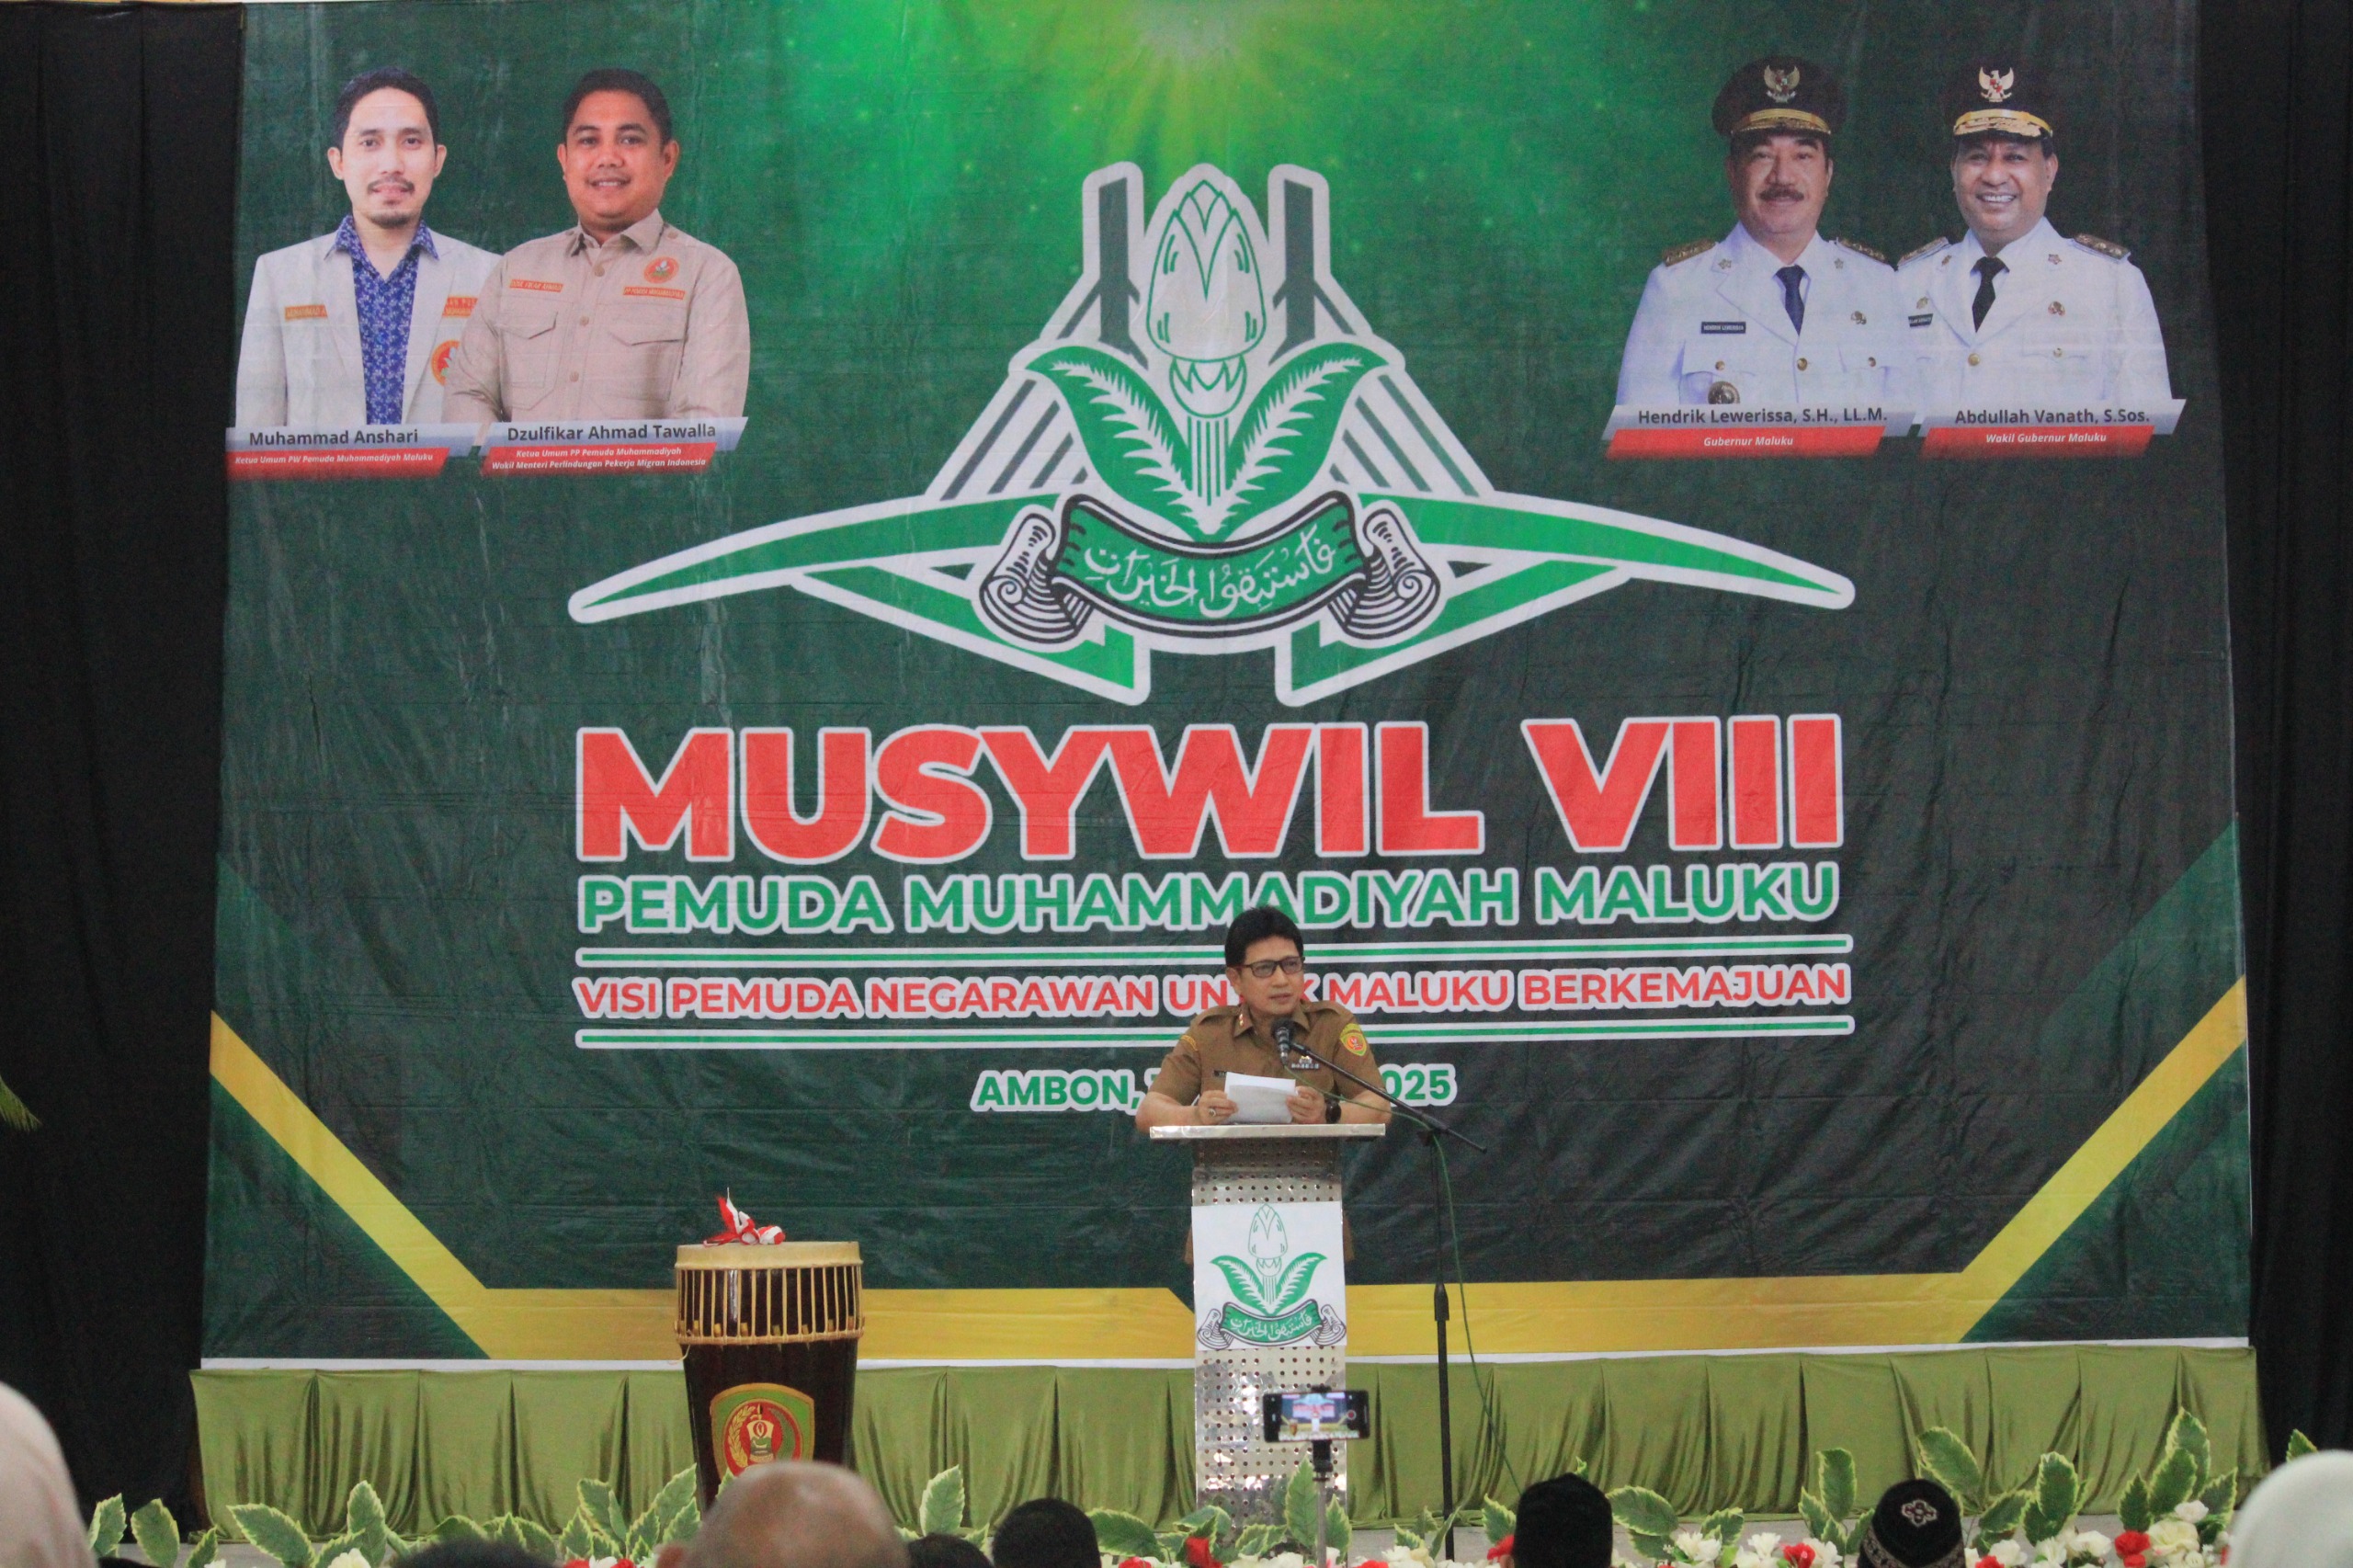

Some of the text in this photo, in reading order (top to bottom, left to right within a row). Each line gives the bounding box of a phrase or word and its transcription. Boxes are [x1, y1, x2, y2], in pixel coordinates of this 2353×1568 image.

[1638, 407, 1887, 425] Hendrik Lewerissa, S.H., LL.M.
[1955, 408, 2150, 425] Abdullah Vanath, S.Sos.
[249, 428, 418, 446] Muhammad Anshari
[507, 424, 716, 441] Dzulfikar Ahmad Tawalla
[1985, 432, 2107, 443] Wakil Gubernur Maluku
[1703, 436, 1793, 447] Gubernur Maluku
[234, 452, 433, 464] Ketua Umum PW Pemuda Muhammadiyah Maluku
[516, 446, 682, 458] Ketua Umum PP Pemuda Muhammadiyah
[492, 457, 706, 471] Wakil Menteri Perlindungan Pekerja Migran Indonesia
[579, 720, 1838, 860] MUSYWIL VIII
[583, 866, 1835, 930] PEMUDA MUHAMMADIYAH MALUKU
[577, 982, 657, 1014] VISI
[672, 981, 860, 1014] PEMUDA
[871, 980, 1153, 1013] NEGARAWAN
[1328, 975, 1509, 1008] MALUKU
[1524, 969, 1846, 1006] BERKEMAJUAN
[976, 1074, 1141, 1110] AMBON,
